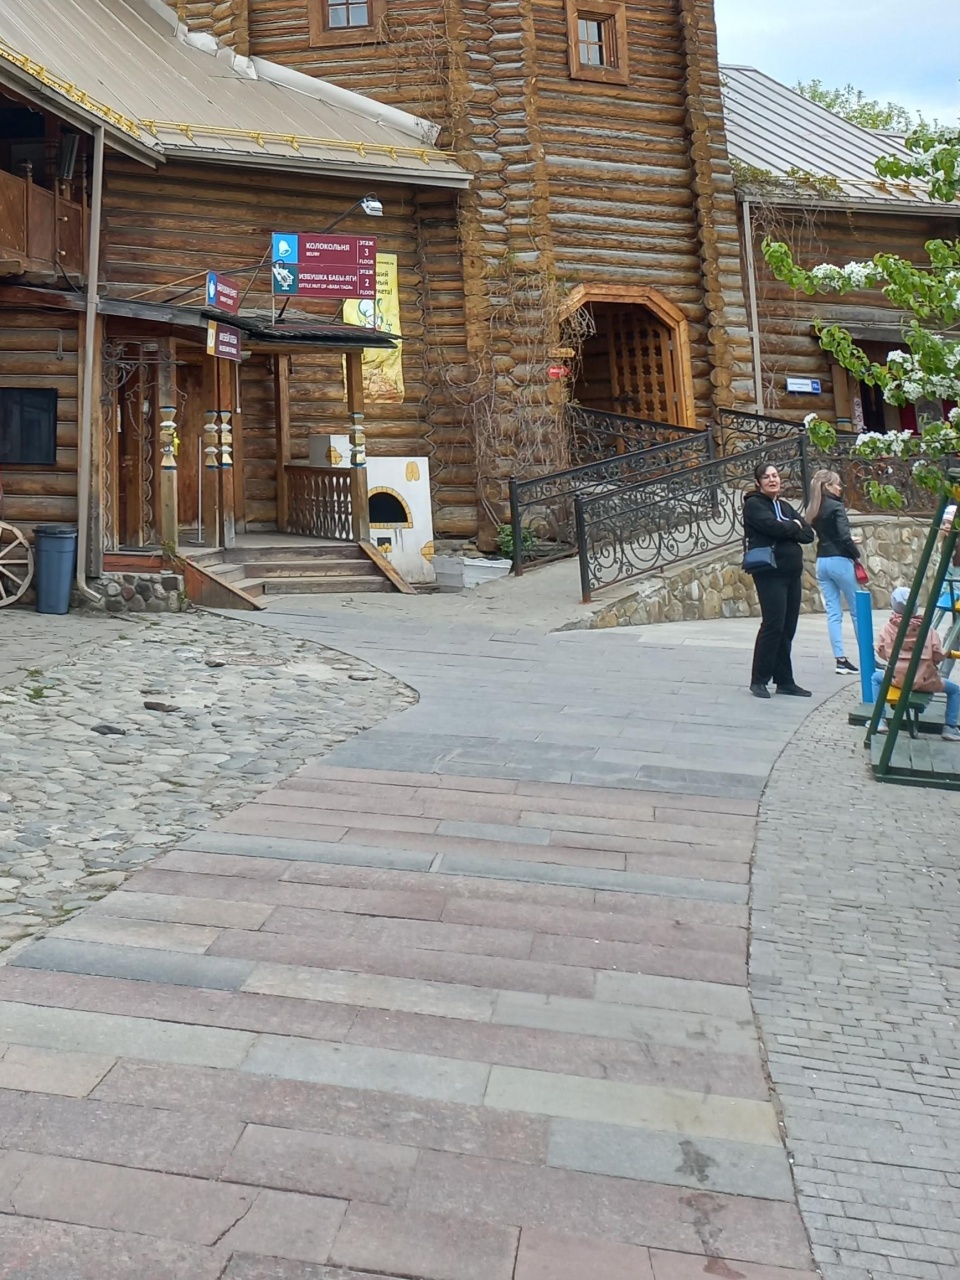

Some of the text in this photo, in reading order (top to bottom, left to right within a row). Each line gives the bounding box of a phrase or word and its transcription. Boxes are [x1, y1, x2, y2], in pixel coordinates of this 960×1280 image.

[306, 243, 350, 251] КОЛОКОЛЬНЯ
[299, 273, 357, 282] ИЗБУШКА БАБЫ-ЯГИ
[365, 279, 369, 287] 2
